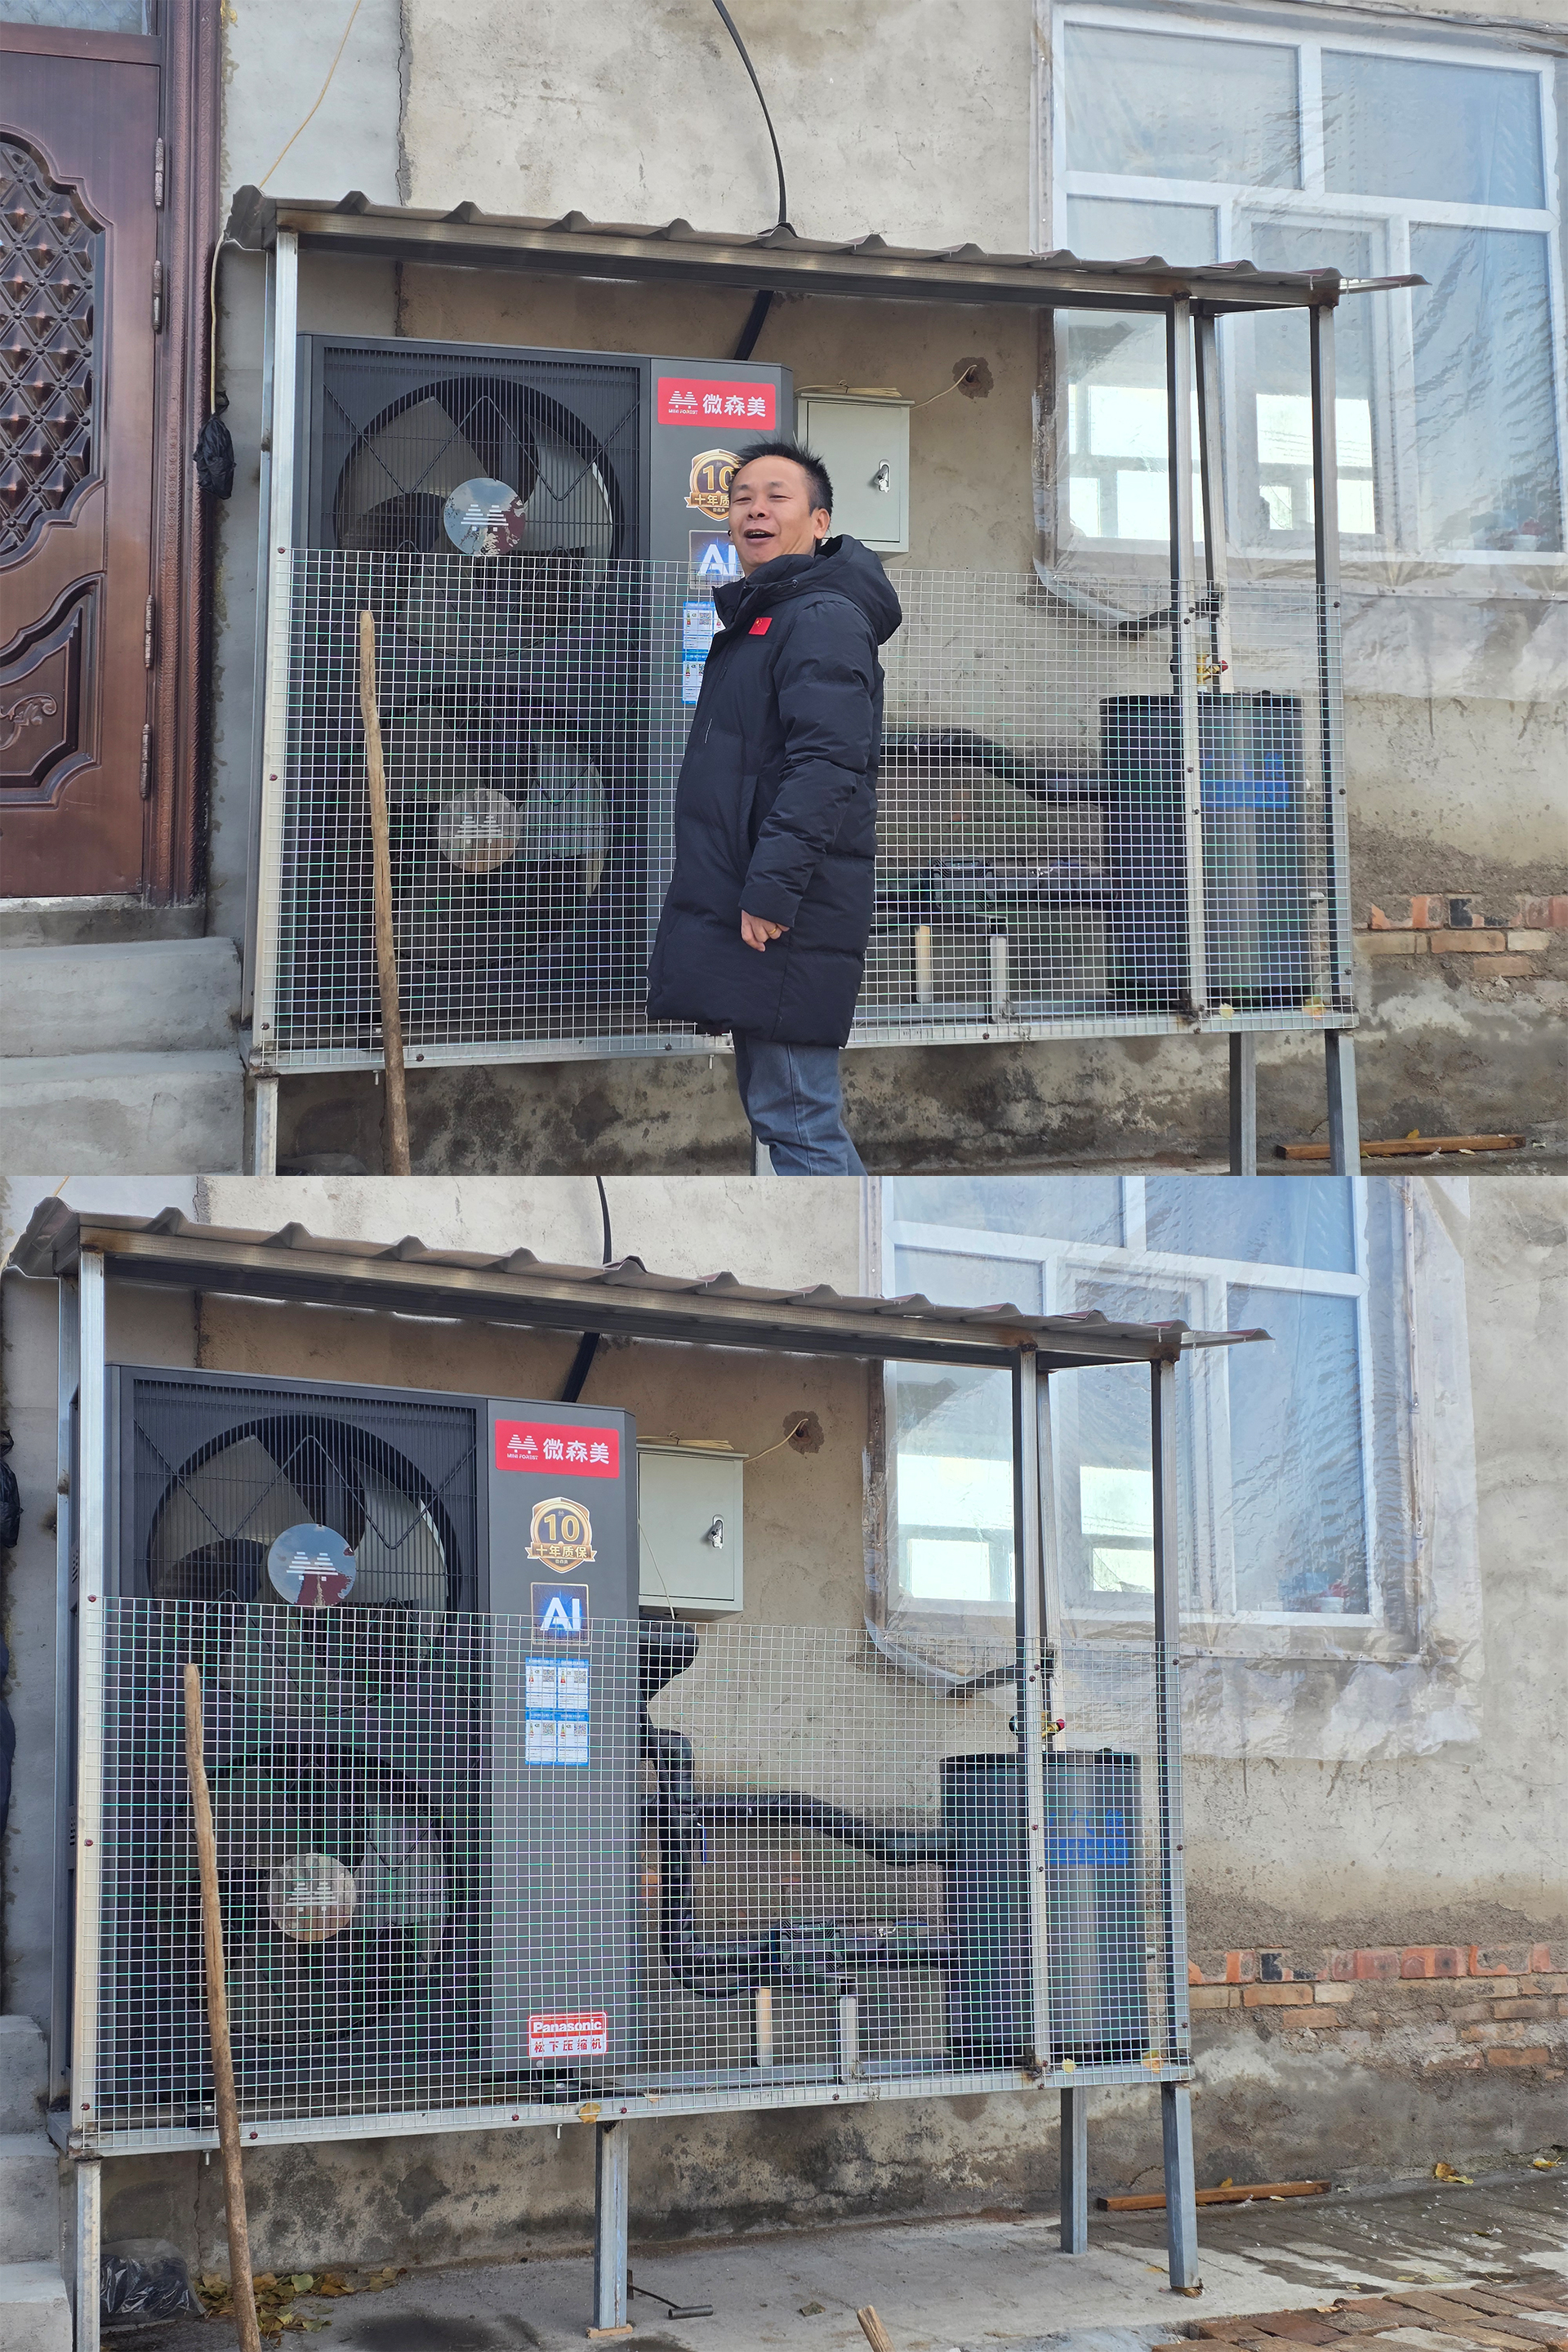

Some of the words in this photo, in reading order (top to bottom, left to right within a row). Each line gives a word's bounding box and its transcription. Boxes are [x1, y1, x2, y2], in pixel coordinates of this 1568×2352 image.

[702, 394, 766, 417] 微森美
[697, 544, 738, 577] AI
[542, 1437, 610, 1464] 微森美
[544, 1513, 580, 1542] 10
[536, 1544, 587, 1558] 十年质保
[540, 1597, 581, 1632] AI
[532, 2019, 602, 2034] Panasonic
[534, 2038, 602, 2053] 松下压缩机
